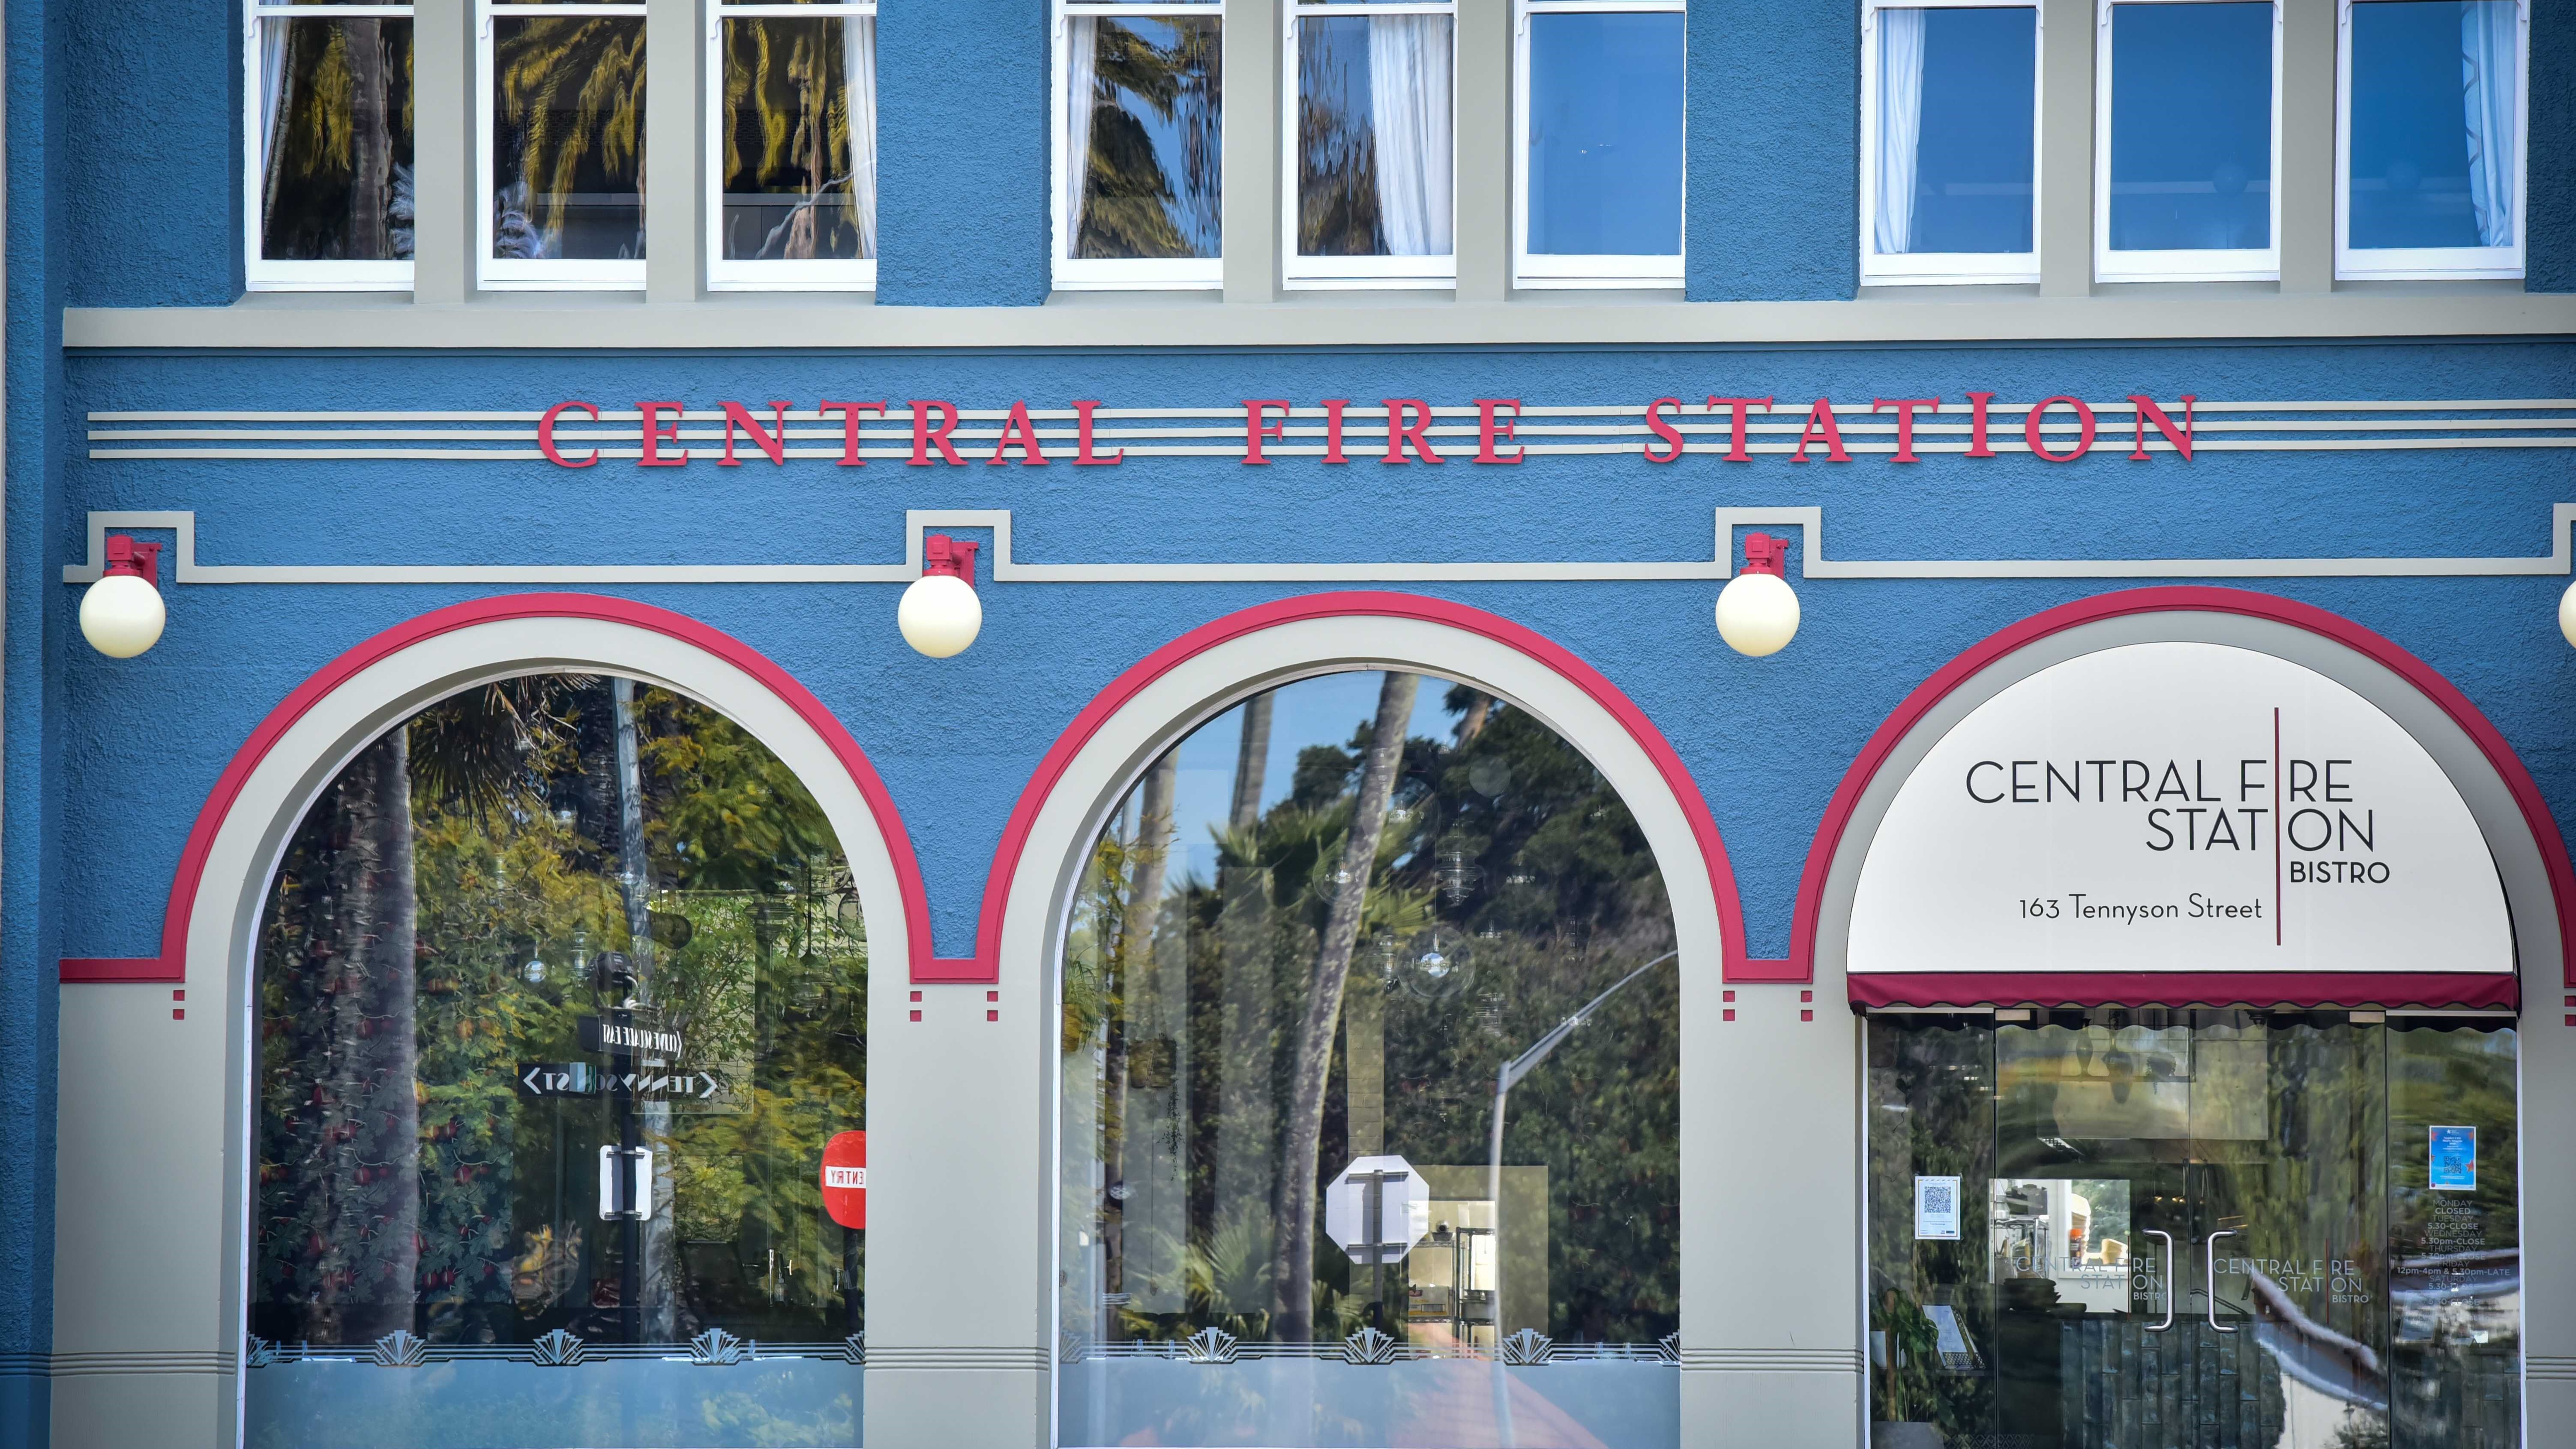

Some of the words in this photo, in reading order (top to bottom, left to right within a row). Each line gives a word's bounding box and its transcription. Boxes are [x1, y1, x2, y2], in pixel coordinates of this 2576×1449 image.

[538, 399, 1124, 467] CENTRAL
[1242, 398, 1525, 464] FIRE
[1644, 392, 2196, 463] STATION
[1966, 759, 2221, 803] CENTRAL
[2291, 861, 2390, 883] BISTRO
[2020, 898, 2059, 919] 163
[2069, 894, 2178, 925] Tennyson
[2188, 893, 2262, 918] Street
[2420, 1238, 2486, 1246] 5.30pm-CLOSE
[2214, 1258, 2309, 1275] CENTRAL
[2397, 1267, 2441, 1276] 12pm-4pm
[2333, 1295, 2369, 1303] BISTRO
